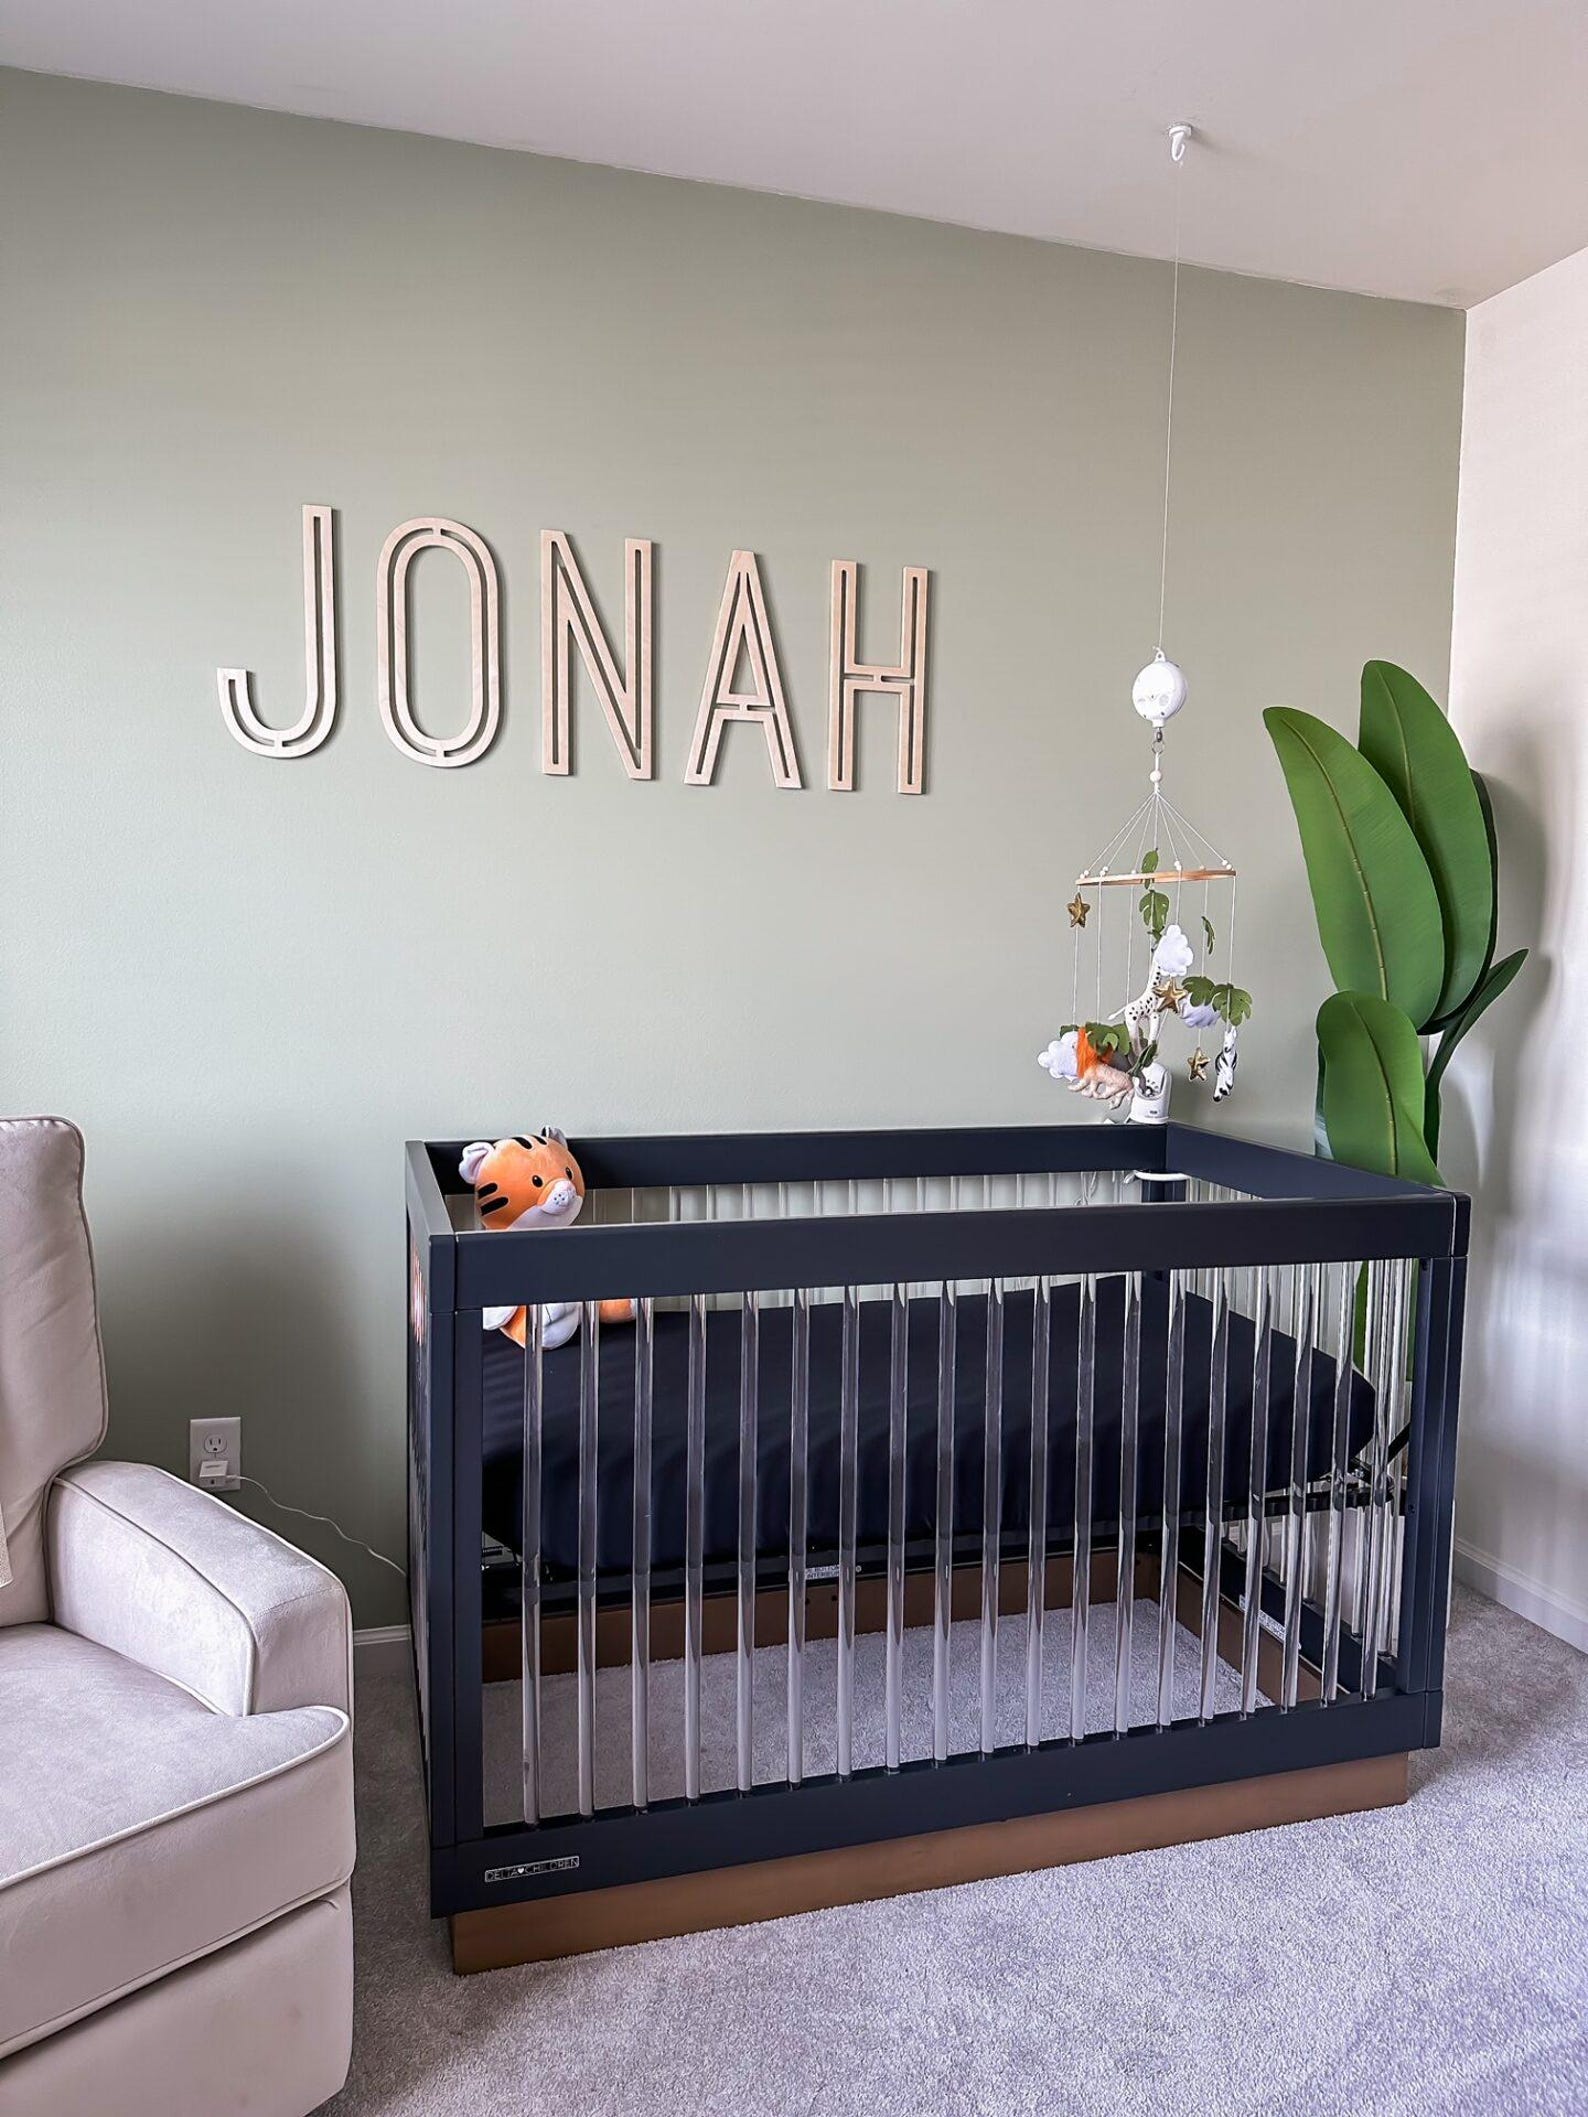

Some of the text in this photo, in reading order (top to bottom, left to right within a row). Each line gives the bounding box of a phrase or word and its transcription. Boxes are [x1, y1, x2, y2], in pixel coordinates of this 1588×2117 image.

[216, 504, 928, 795] JONAH
[487, 1859, 579, 1881] DELTA CHILDREN
